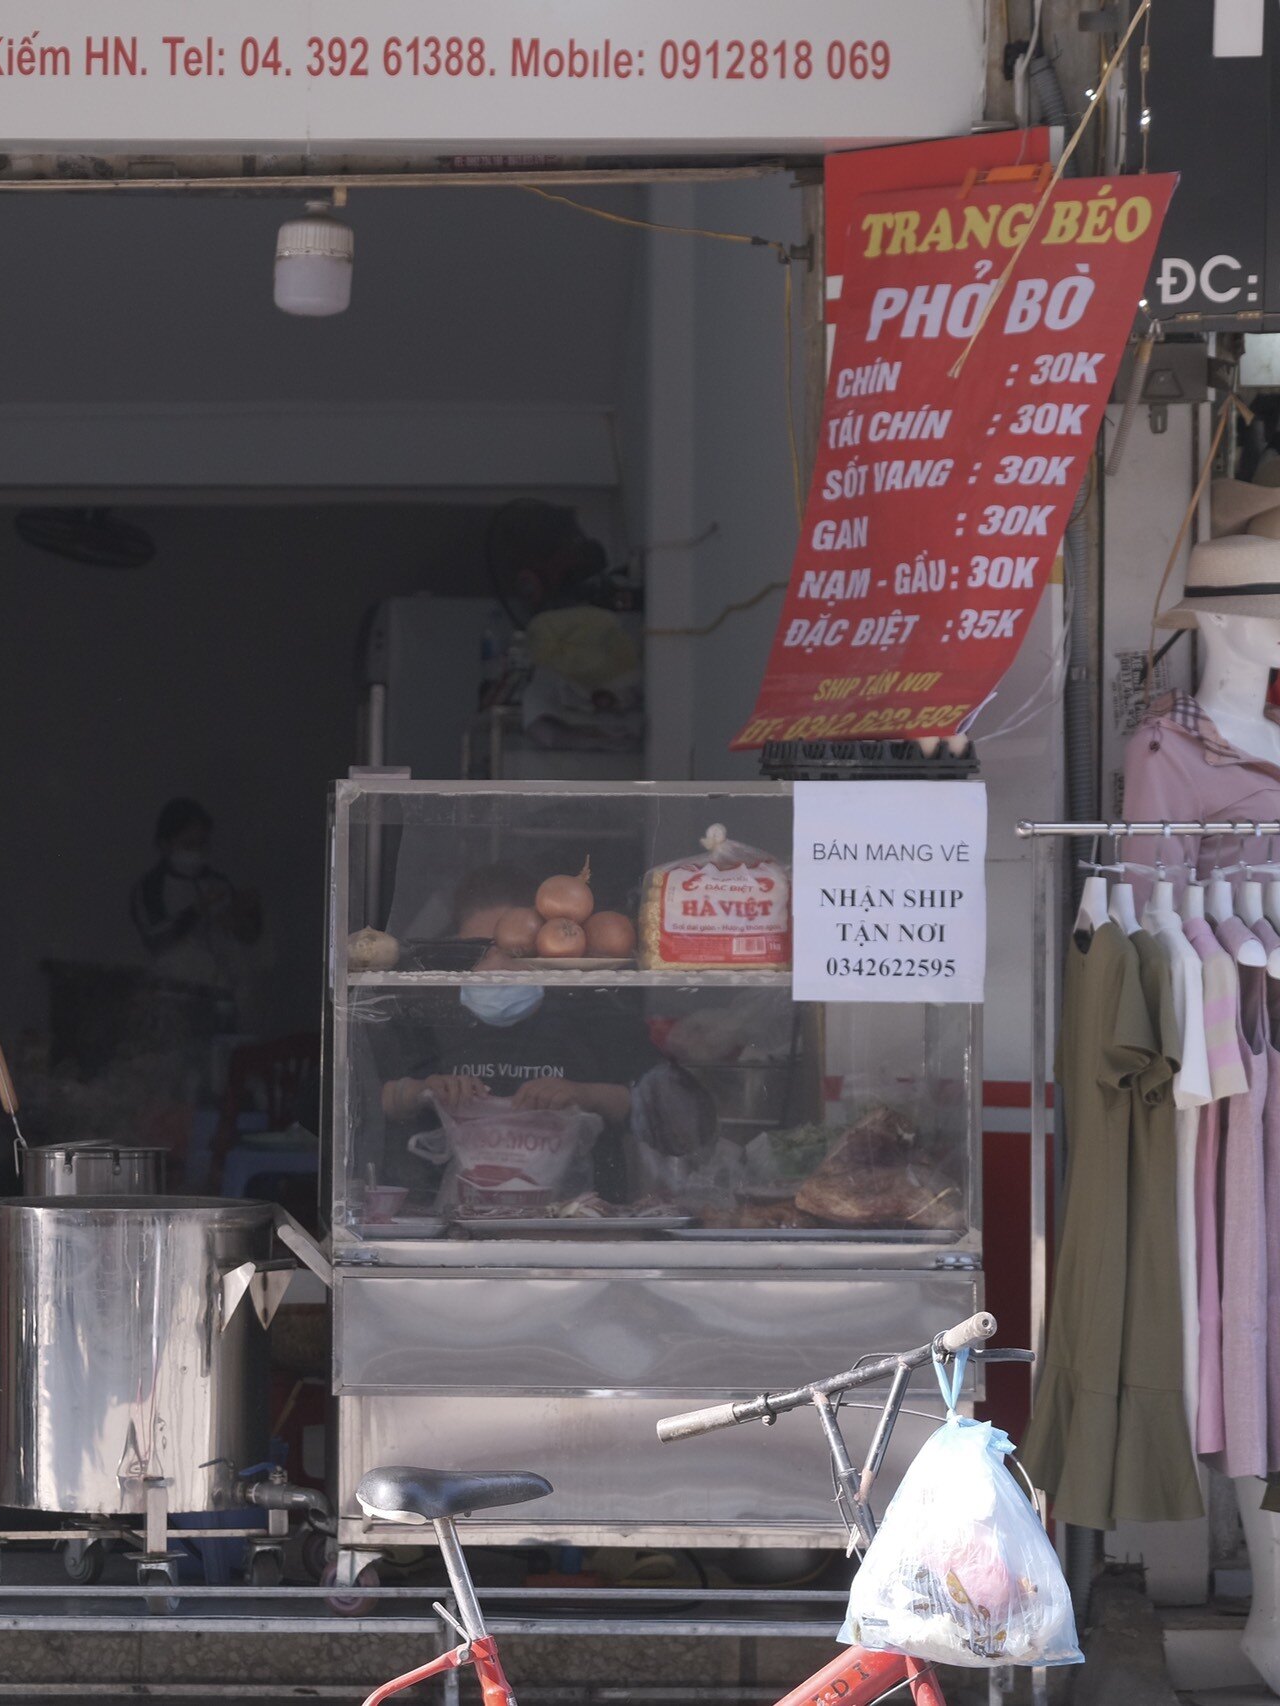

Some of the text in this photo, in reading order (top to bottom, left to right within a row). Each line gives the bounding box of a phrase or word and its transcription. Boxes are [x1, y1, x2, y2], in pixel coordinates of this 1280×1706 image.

[84, 36, 148, 76] HN.
[161, 36, 226, 77] Tel:
[239, 36, 292, 77] 04.
[306, 36, 369, 77] 392
[382, 36, 497, 77] 61388.
[659, 39, 814, 80] 0912818
[826, 39, 891, 80] 069
[861, 184, 1153, 258] TRANG BÉO
[1156, 254, 1259, 305] ĐC:
[865, 258, 1096, 342] PHỞ BÒ
[835, 357, 902, 399] CHÍN
[827, 409, 864, 449] TÁI
[868, 404, 953, 443] CHÍN
[822, 455, 869, 500] SỐT
[873, 458, 955, 493] VANG
[811, 515, 870, 551] GAN
[798, 567, 872, 607] NẠM
[783, 612, 850, 653] ĐẶC
[850, 608, 920, 651] BIỆT
[813, 676, 863, 702] SHIP
[812, 839, 970, 862] BÁN MANG VỀ
[682, 895, 774, 921] HÀ VIỆT
[819, 885, 964, 912] NHẬN SHIP
[836, 920, 946, 947] TẬN NƠI
[825, 956, 956, 978] 0342622595
[453, 1063, 565, 1078] LOUIS VUITTON
